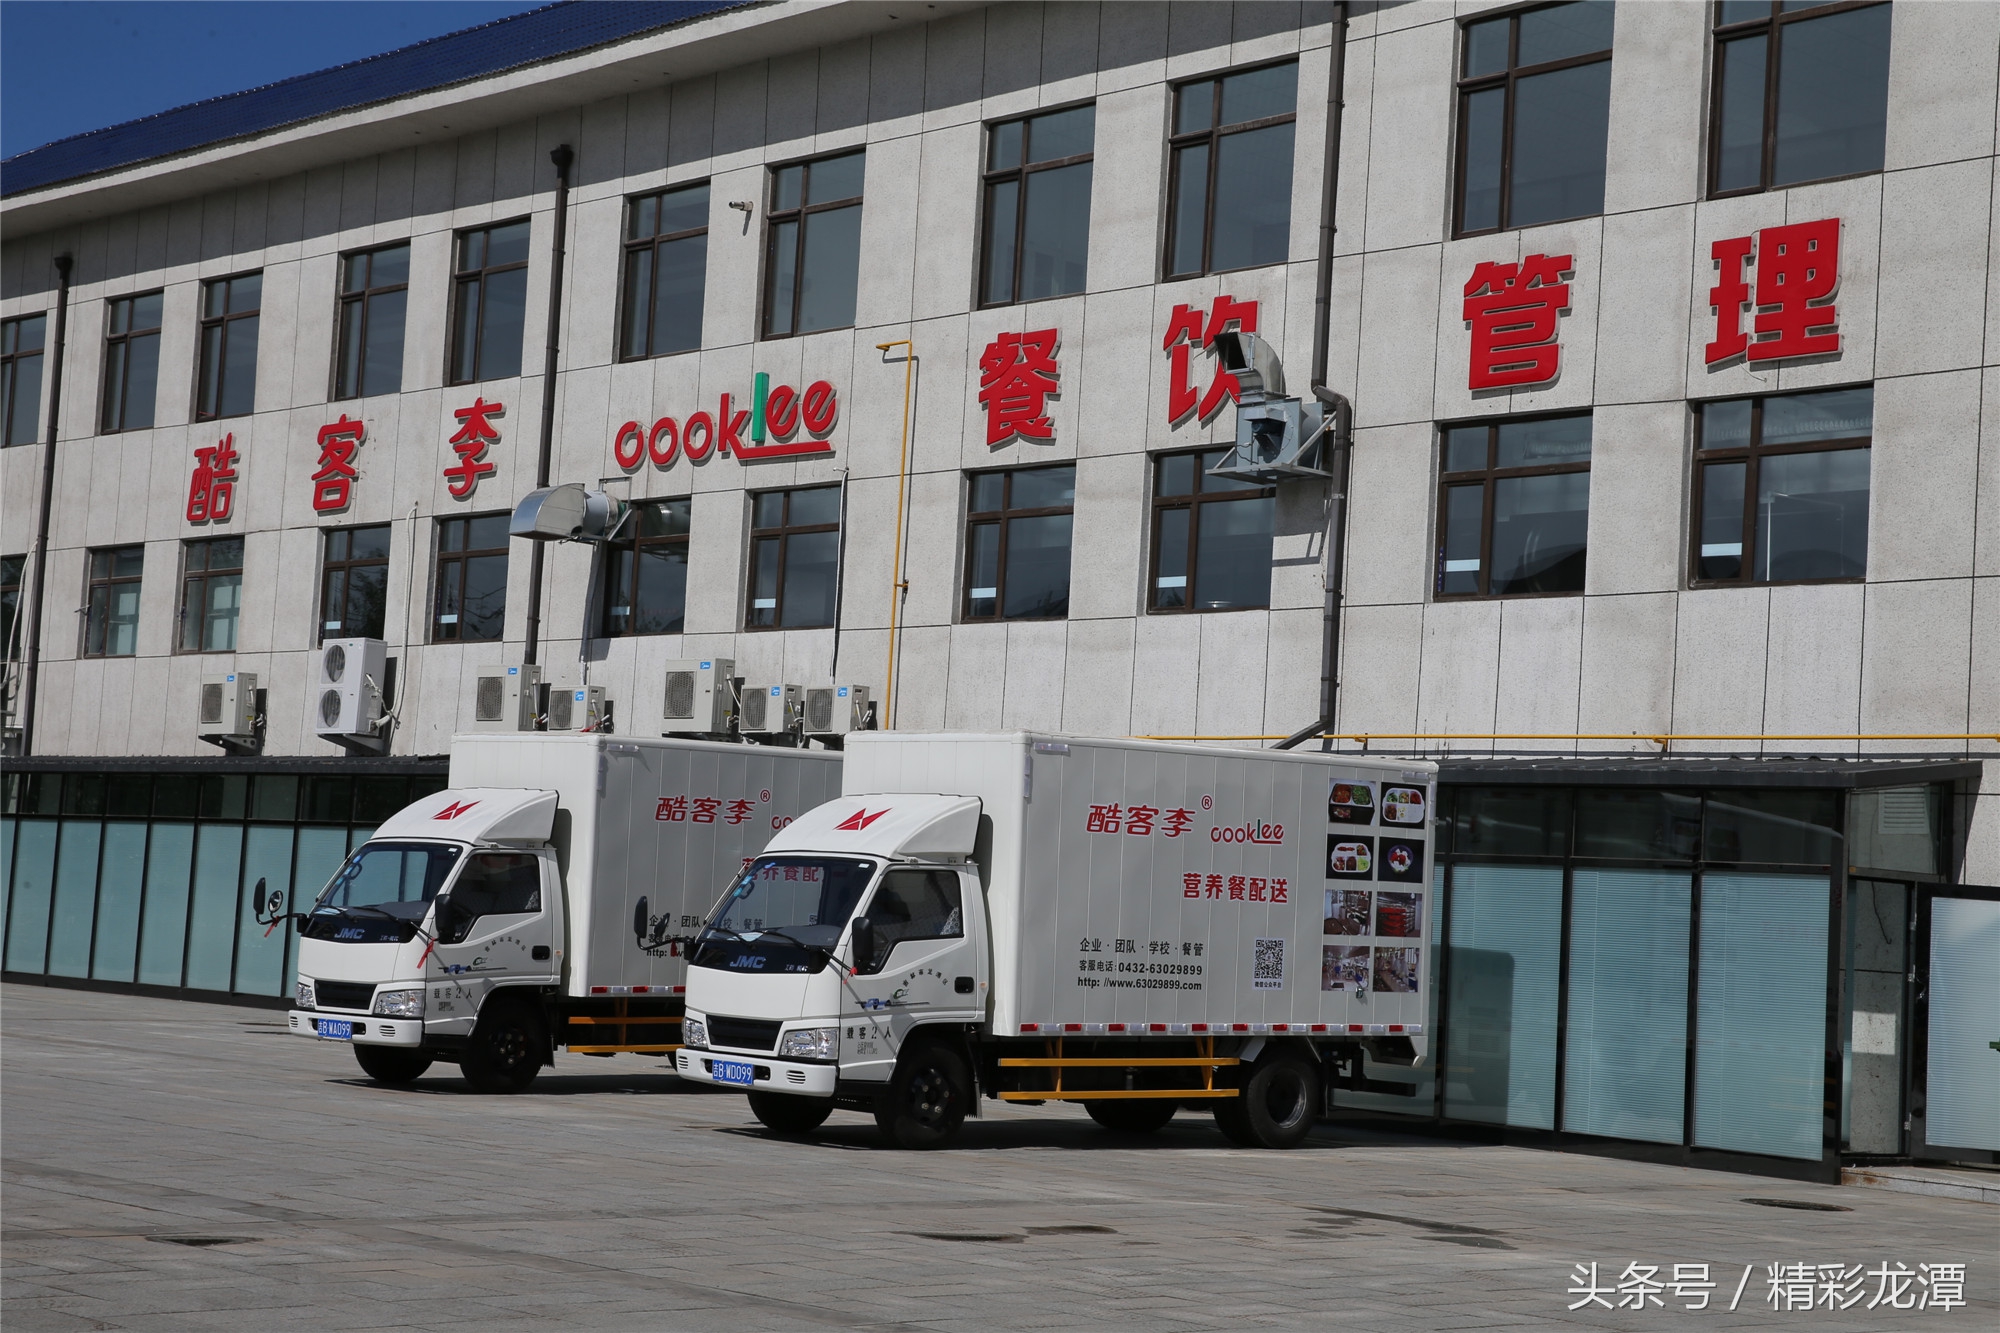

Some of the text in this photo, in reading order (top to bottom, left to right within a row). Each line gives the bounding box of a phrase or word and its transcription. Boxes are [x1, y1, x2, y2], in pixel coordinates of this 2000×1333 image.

[979, 217, 1842, 446] 餐饮管理
[614, 372, 838, 470] cooklee
[186, 397, 503, 522] 酷客李
[655, 795, 756, 825] 酷客李
[1086, 802, 1196, 838] 酷客李
[1210, 819, 1285, 845] cooklee
[1183, 873, 1288, 903] 营养餐配送
[334, 928, 366, 940] JMC
[729, 955, 767, 969] JMC
